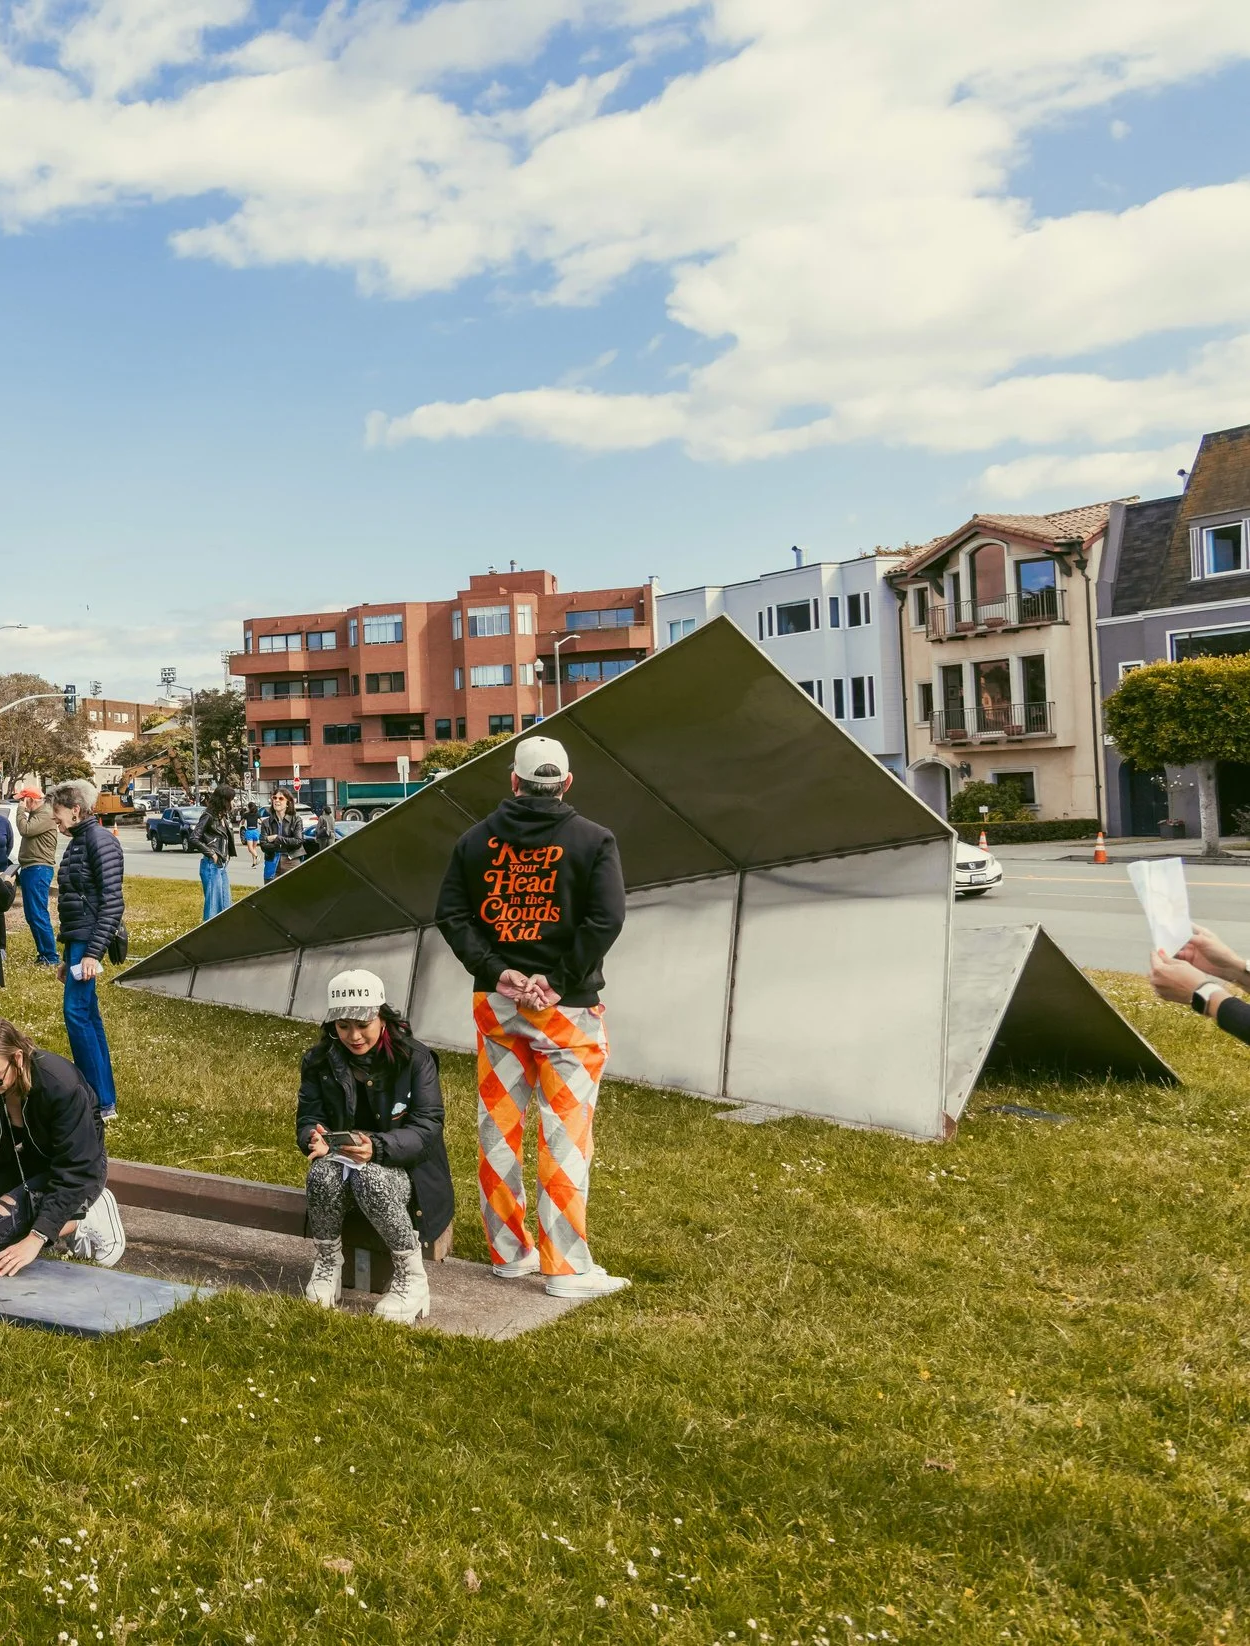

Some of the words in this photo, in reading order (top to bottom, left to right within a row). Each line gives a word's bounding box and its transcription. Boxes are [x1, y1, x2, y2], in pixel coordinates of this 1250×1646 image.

[488, 836, 563, 869] Keep
[508, 864, 539, 874] your
[484, 870, 557, 896] Head
[510, 894, 521, 905] in
[525, 893, 545, 905] the
[480, 896, 561, 924] Clouds
[495, 922, 542, 942] Kid.
[331, 988, 370, 998] CAMPUS
